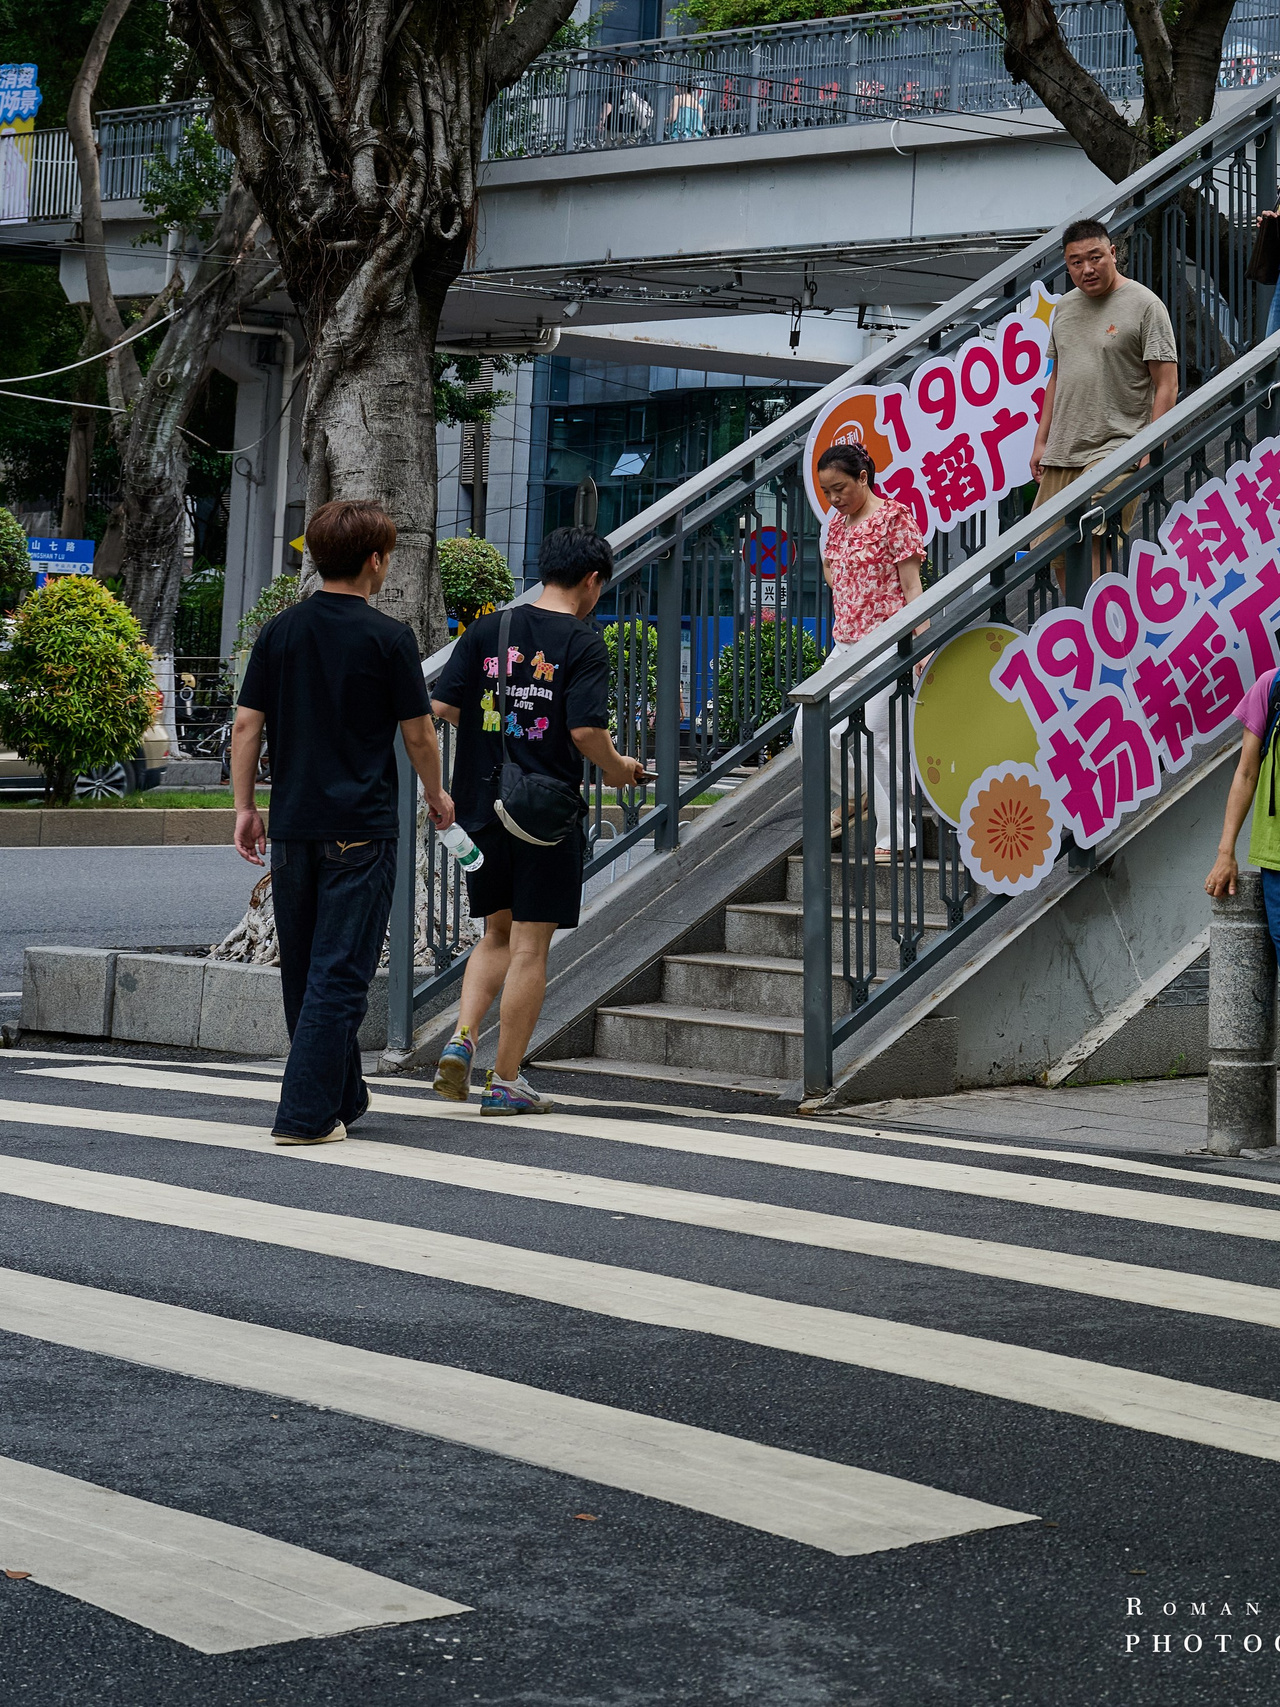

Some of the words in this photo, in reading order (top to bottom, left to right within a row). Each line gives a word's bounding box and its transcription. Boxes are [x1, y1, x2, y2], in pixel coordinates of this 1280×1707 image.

[0, 90, 39, 117] 场景
[882, 322, 1041, 452] 1906
[873, 387, 1046, 537] 扬韬广
[31, 539, 76, 552] 山七路
